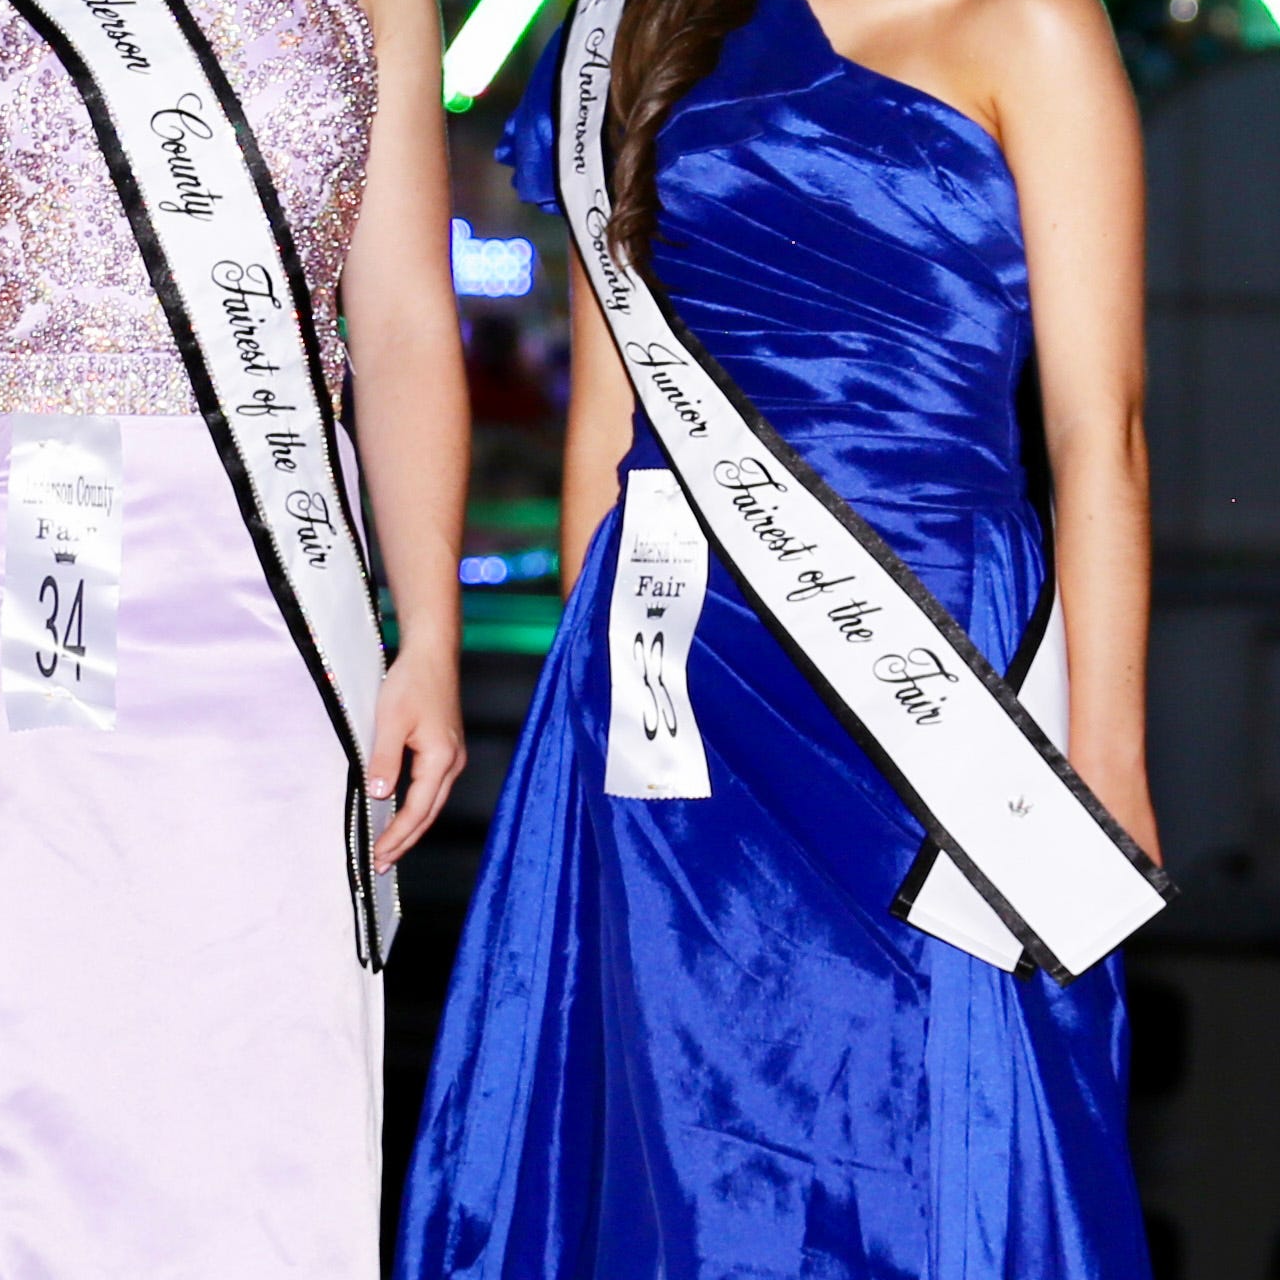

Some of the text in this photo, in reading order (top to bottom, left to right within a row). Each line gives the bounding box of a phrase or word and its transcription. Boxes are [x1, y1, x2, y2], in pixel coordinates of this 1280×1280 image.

[149, 91, 224, 222] County
[211, 259, 283, 377] Fairest
[236, 388, 297, 418] of
[577, 26, 960, 727] Anderson County Junior Fairest of the Fair
[265, 428, 307, 473] the
[77, 475, 115, 518] County
[35, 517, 98, 542] Fa
[285, 489, 339, 570] Fair
[635, 575, 686, 598] Fair
[35, 575, 87, 682] 34
